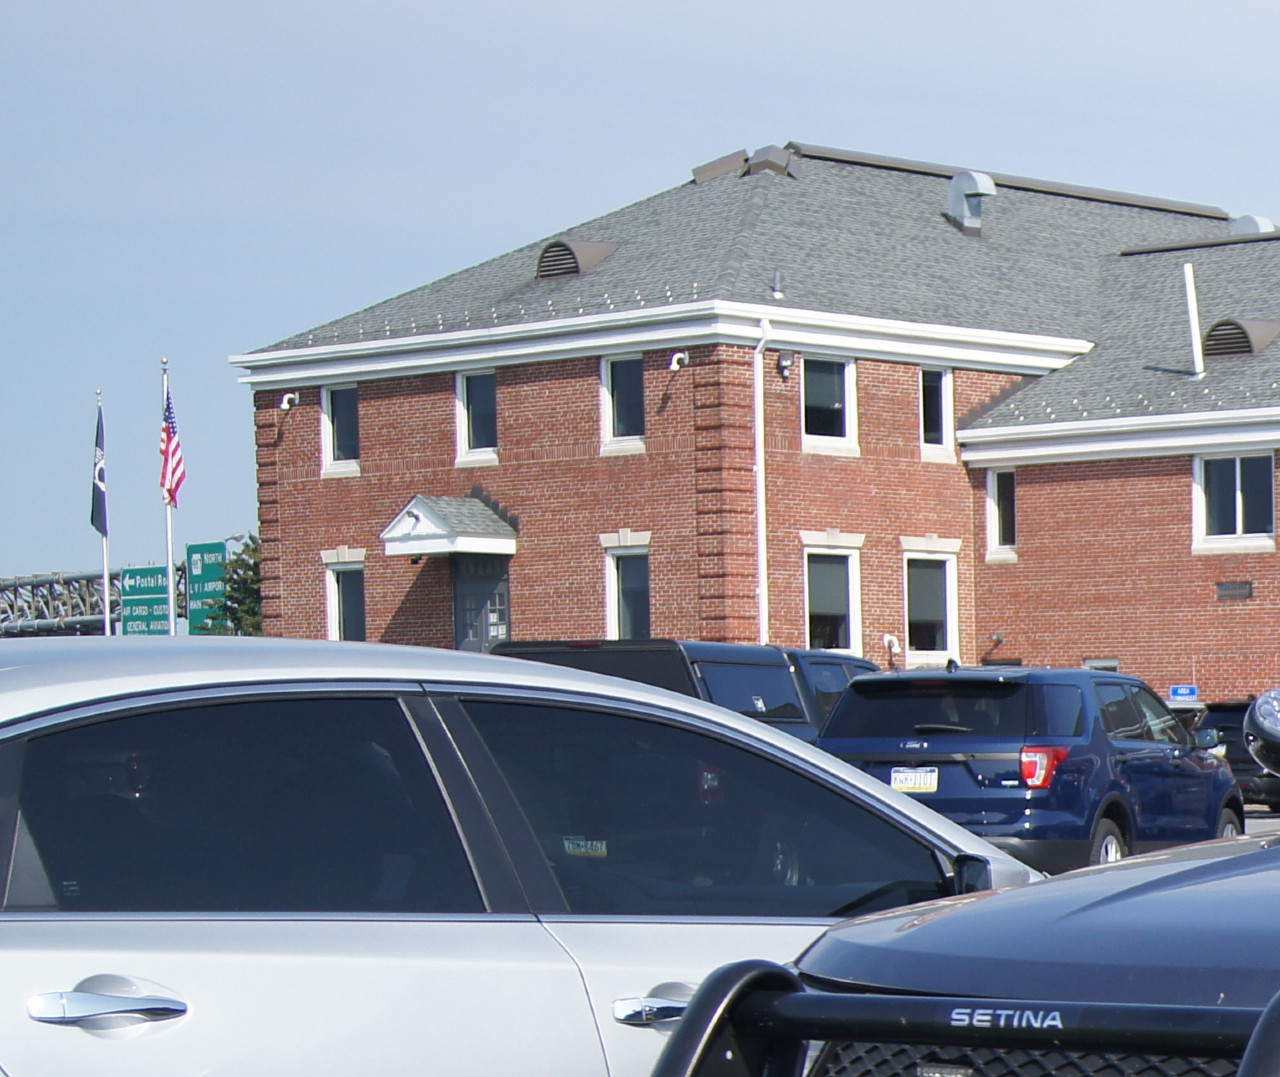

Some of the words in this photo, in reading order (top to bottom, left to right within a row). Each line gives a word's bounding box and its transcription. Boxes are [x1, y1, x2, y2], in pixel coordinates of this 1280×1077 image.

[136, 574, 156, 588] Postal
[153, 605, 168, 616] CUSTO
[950, 1008, 1064, 1029] SETINA
